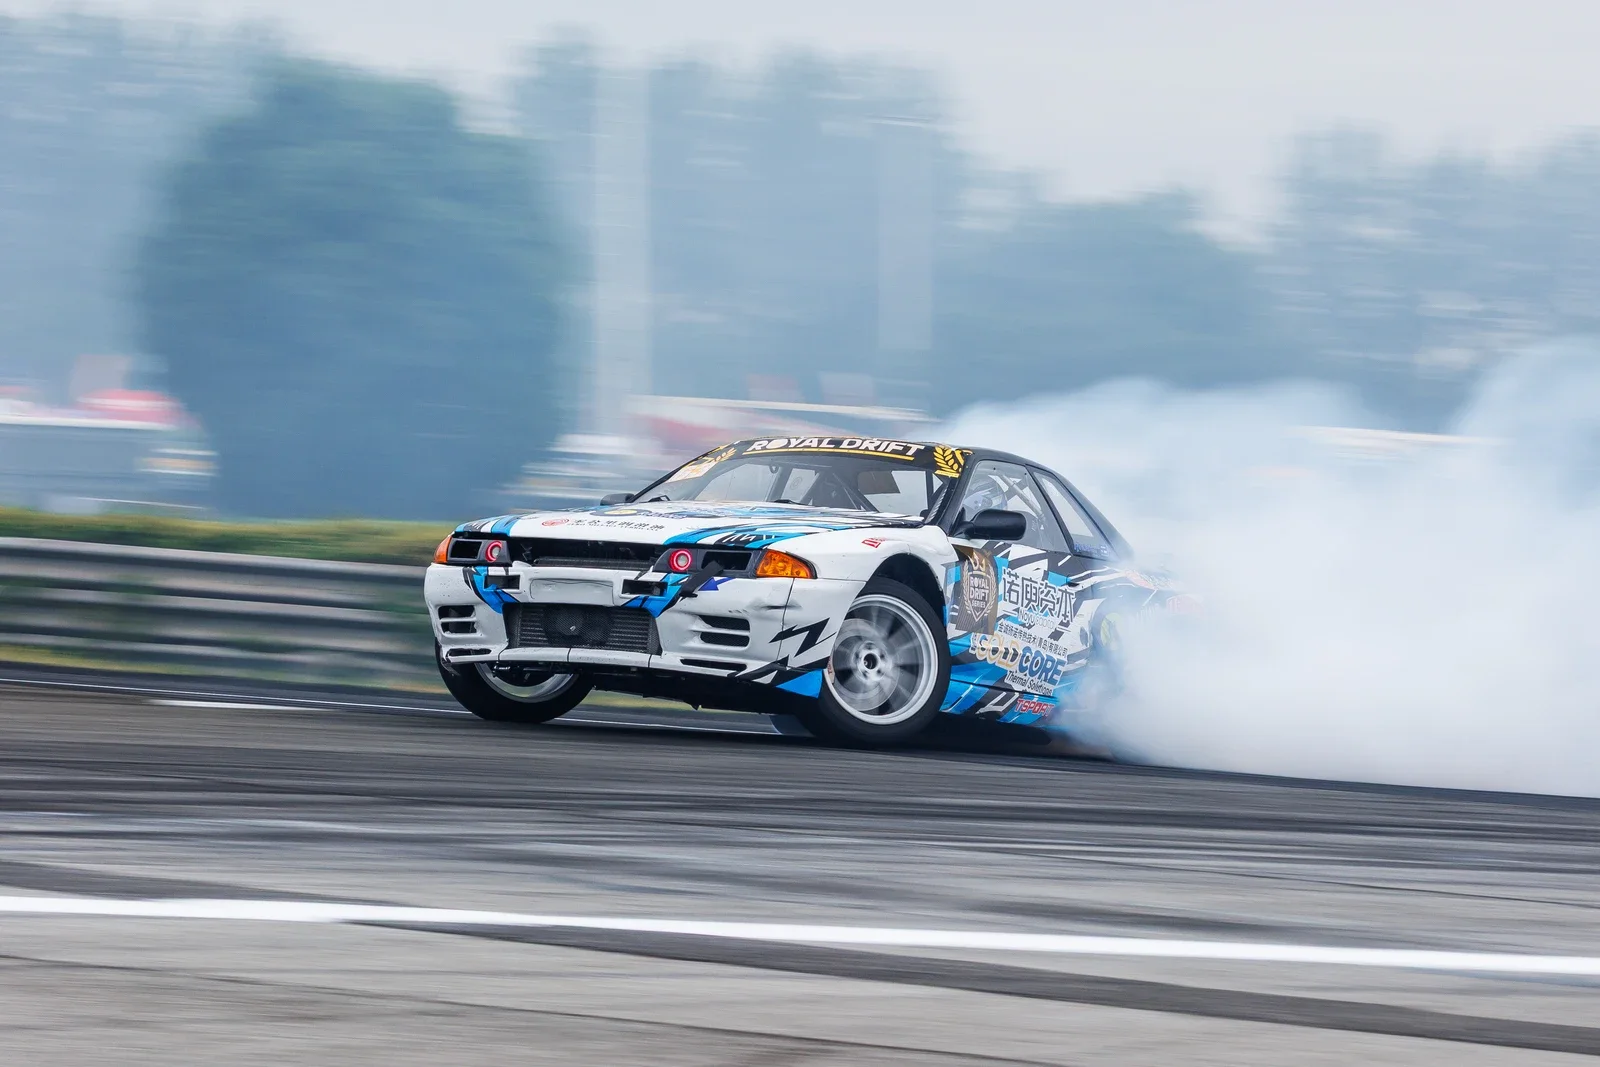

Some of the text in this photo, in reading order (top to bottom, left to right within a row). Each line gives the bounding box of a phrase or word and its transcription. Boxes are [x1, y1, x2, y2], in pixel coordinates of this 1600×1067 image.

[746, 437, 926, 456] ROYAL DRIFT
[970, 576, 989, 589] ROYAL
[970, 587, 989, 601] DRIFT
[972, 600, 986, 608] SERIES
[977, 632, 1020, 669] GOLD
[1018, 646, 1067, 686] CORE
[1005, 670, 1052, 696] Thermal Solutions
[1015, 699, 1055, 717] TSPORT
